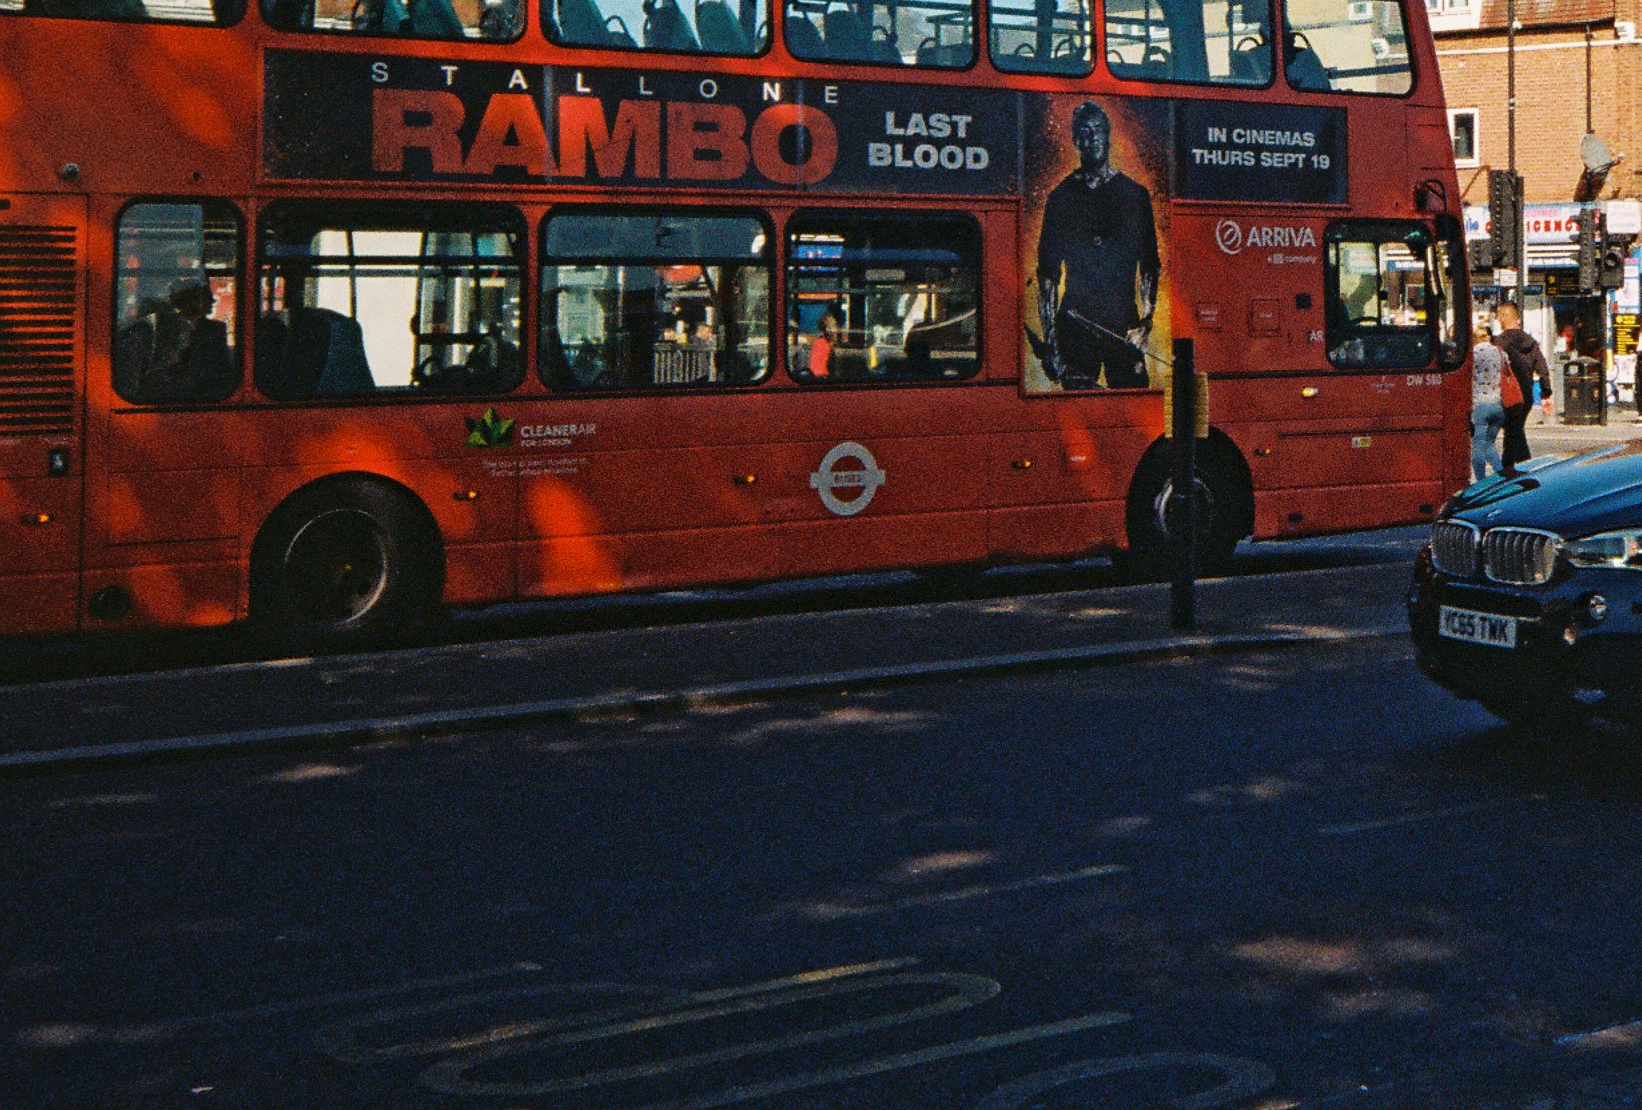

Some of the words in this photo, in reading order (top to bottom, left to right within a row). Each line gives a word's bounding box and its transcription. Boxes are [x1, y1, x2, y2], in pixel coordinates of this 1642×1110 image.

[371, 61, 840, 104] STALLONE
[371, 88, 839, 186] RAMBO
[885, 111, 972, 138] LAST
[1207, 127, 1229, 143] IN
[1234, 129, 1316, 147] CINEMAS
[868, 143, 989, 170] BLOOD
[1192, 149, 1256, 166] THURS
[1260, 152, 1306, 169] SEPT
[1310, 154, 1330, 170] 19
[1246, 227, 1317, 248] ARRIVA
